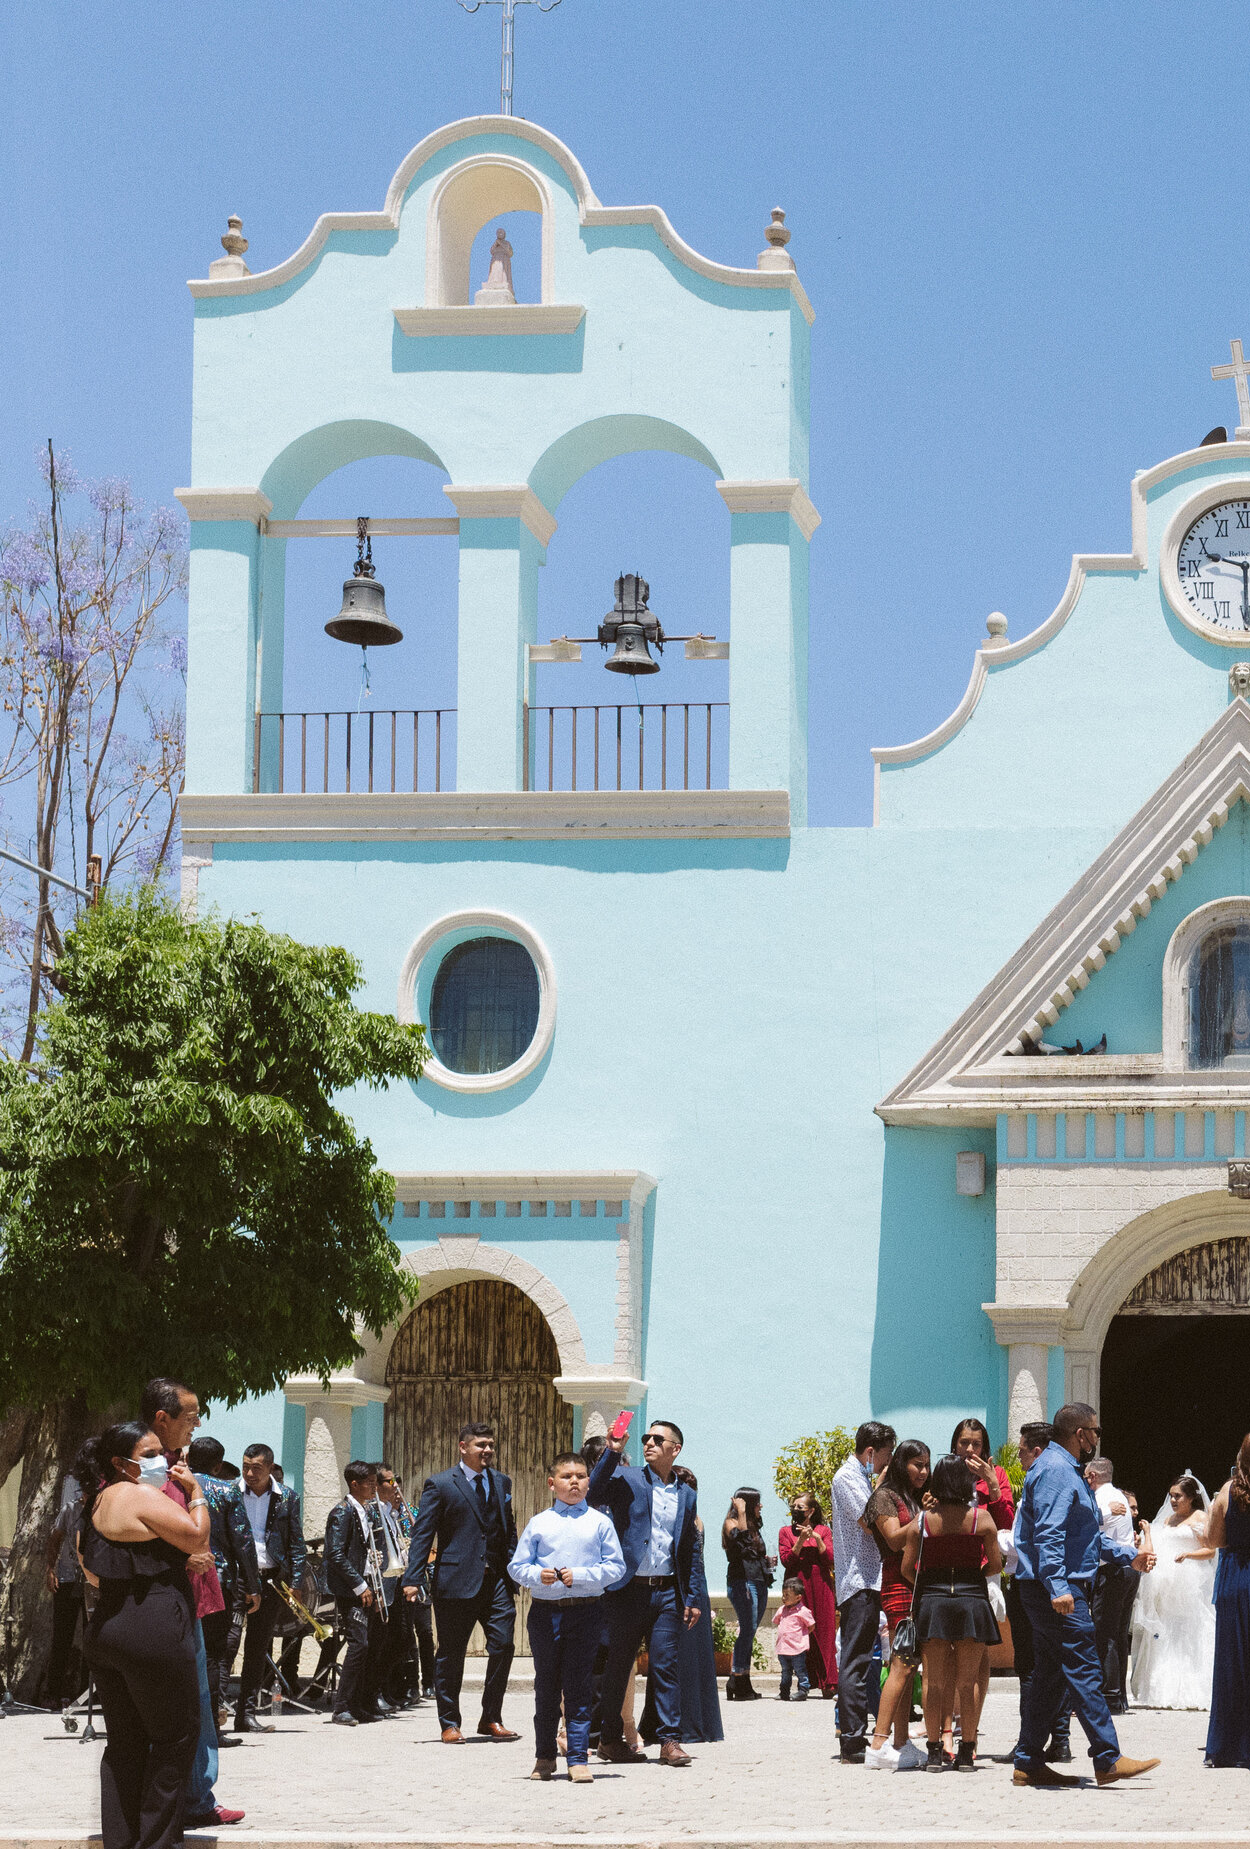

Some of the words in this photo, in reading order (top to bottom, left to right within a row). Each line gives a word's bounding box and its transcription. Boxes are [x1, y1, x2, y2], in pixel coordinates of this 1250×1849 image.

[1216, 520, 1229, 537] XI
[1199, 537, 1209, 555] X
[1188, 560, 1201, 577] IX
[1193, 582, 1214, 599] VIII
[1213, 601, 1230, 618] VII
